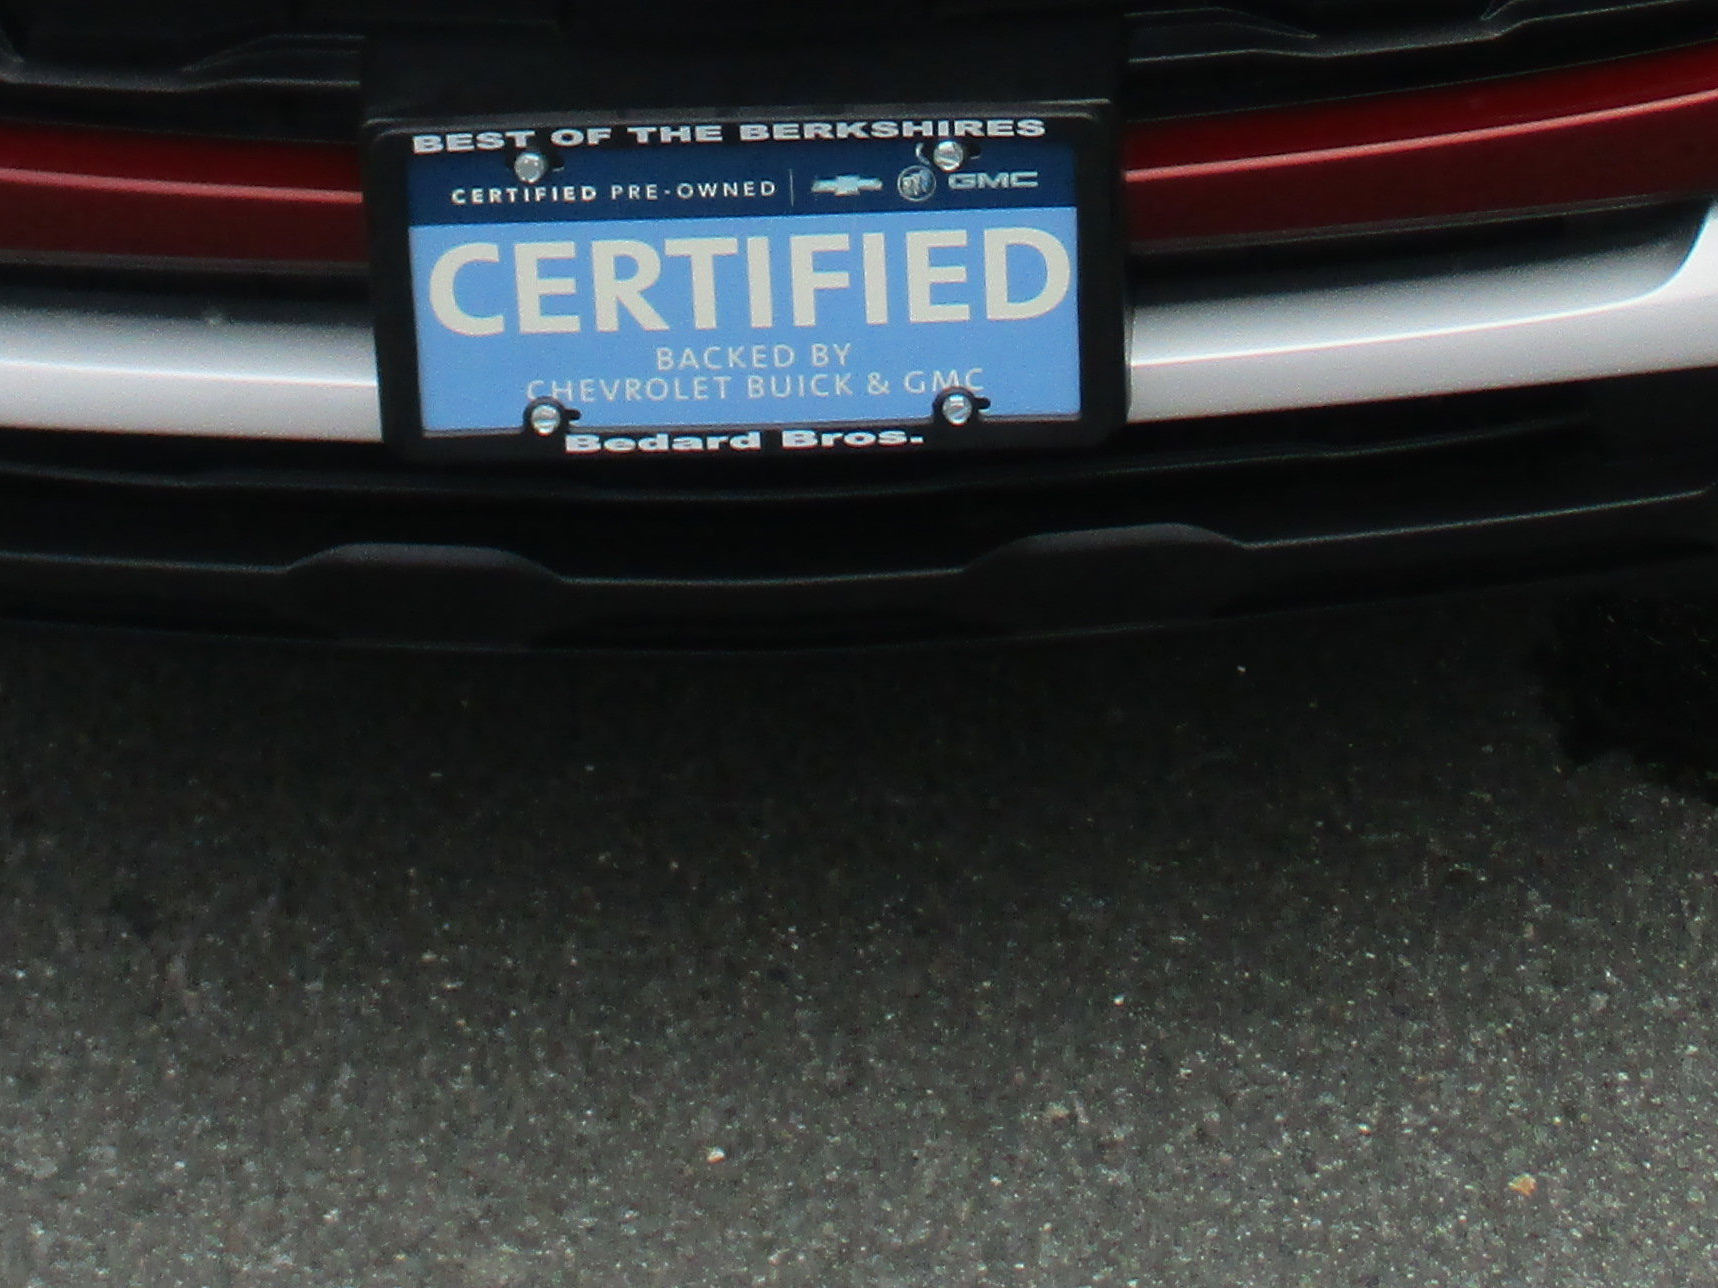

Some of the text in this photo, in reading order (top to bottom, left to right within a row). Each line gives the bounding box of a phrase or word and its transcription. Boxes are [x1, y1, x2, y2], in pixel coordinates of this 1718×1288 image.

[412, 119, 1046, 154] BEST OF THE BERKSHIRES
[451, 180, 776, 205] CERTIFIED PRE-OWNED
[948, 171, 1039, 190] GMC
[427, 227, 1071, 337] CERTIFIED
[656, 342, 852, 371] BACKED BY
[527, 367, 985, 403] CHEVROLET BUICK & GMC
[565, 428, 924, 453] Bedard Bros.
